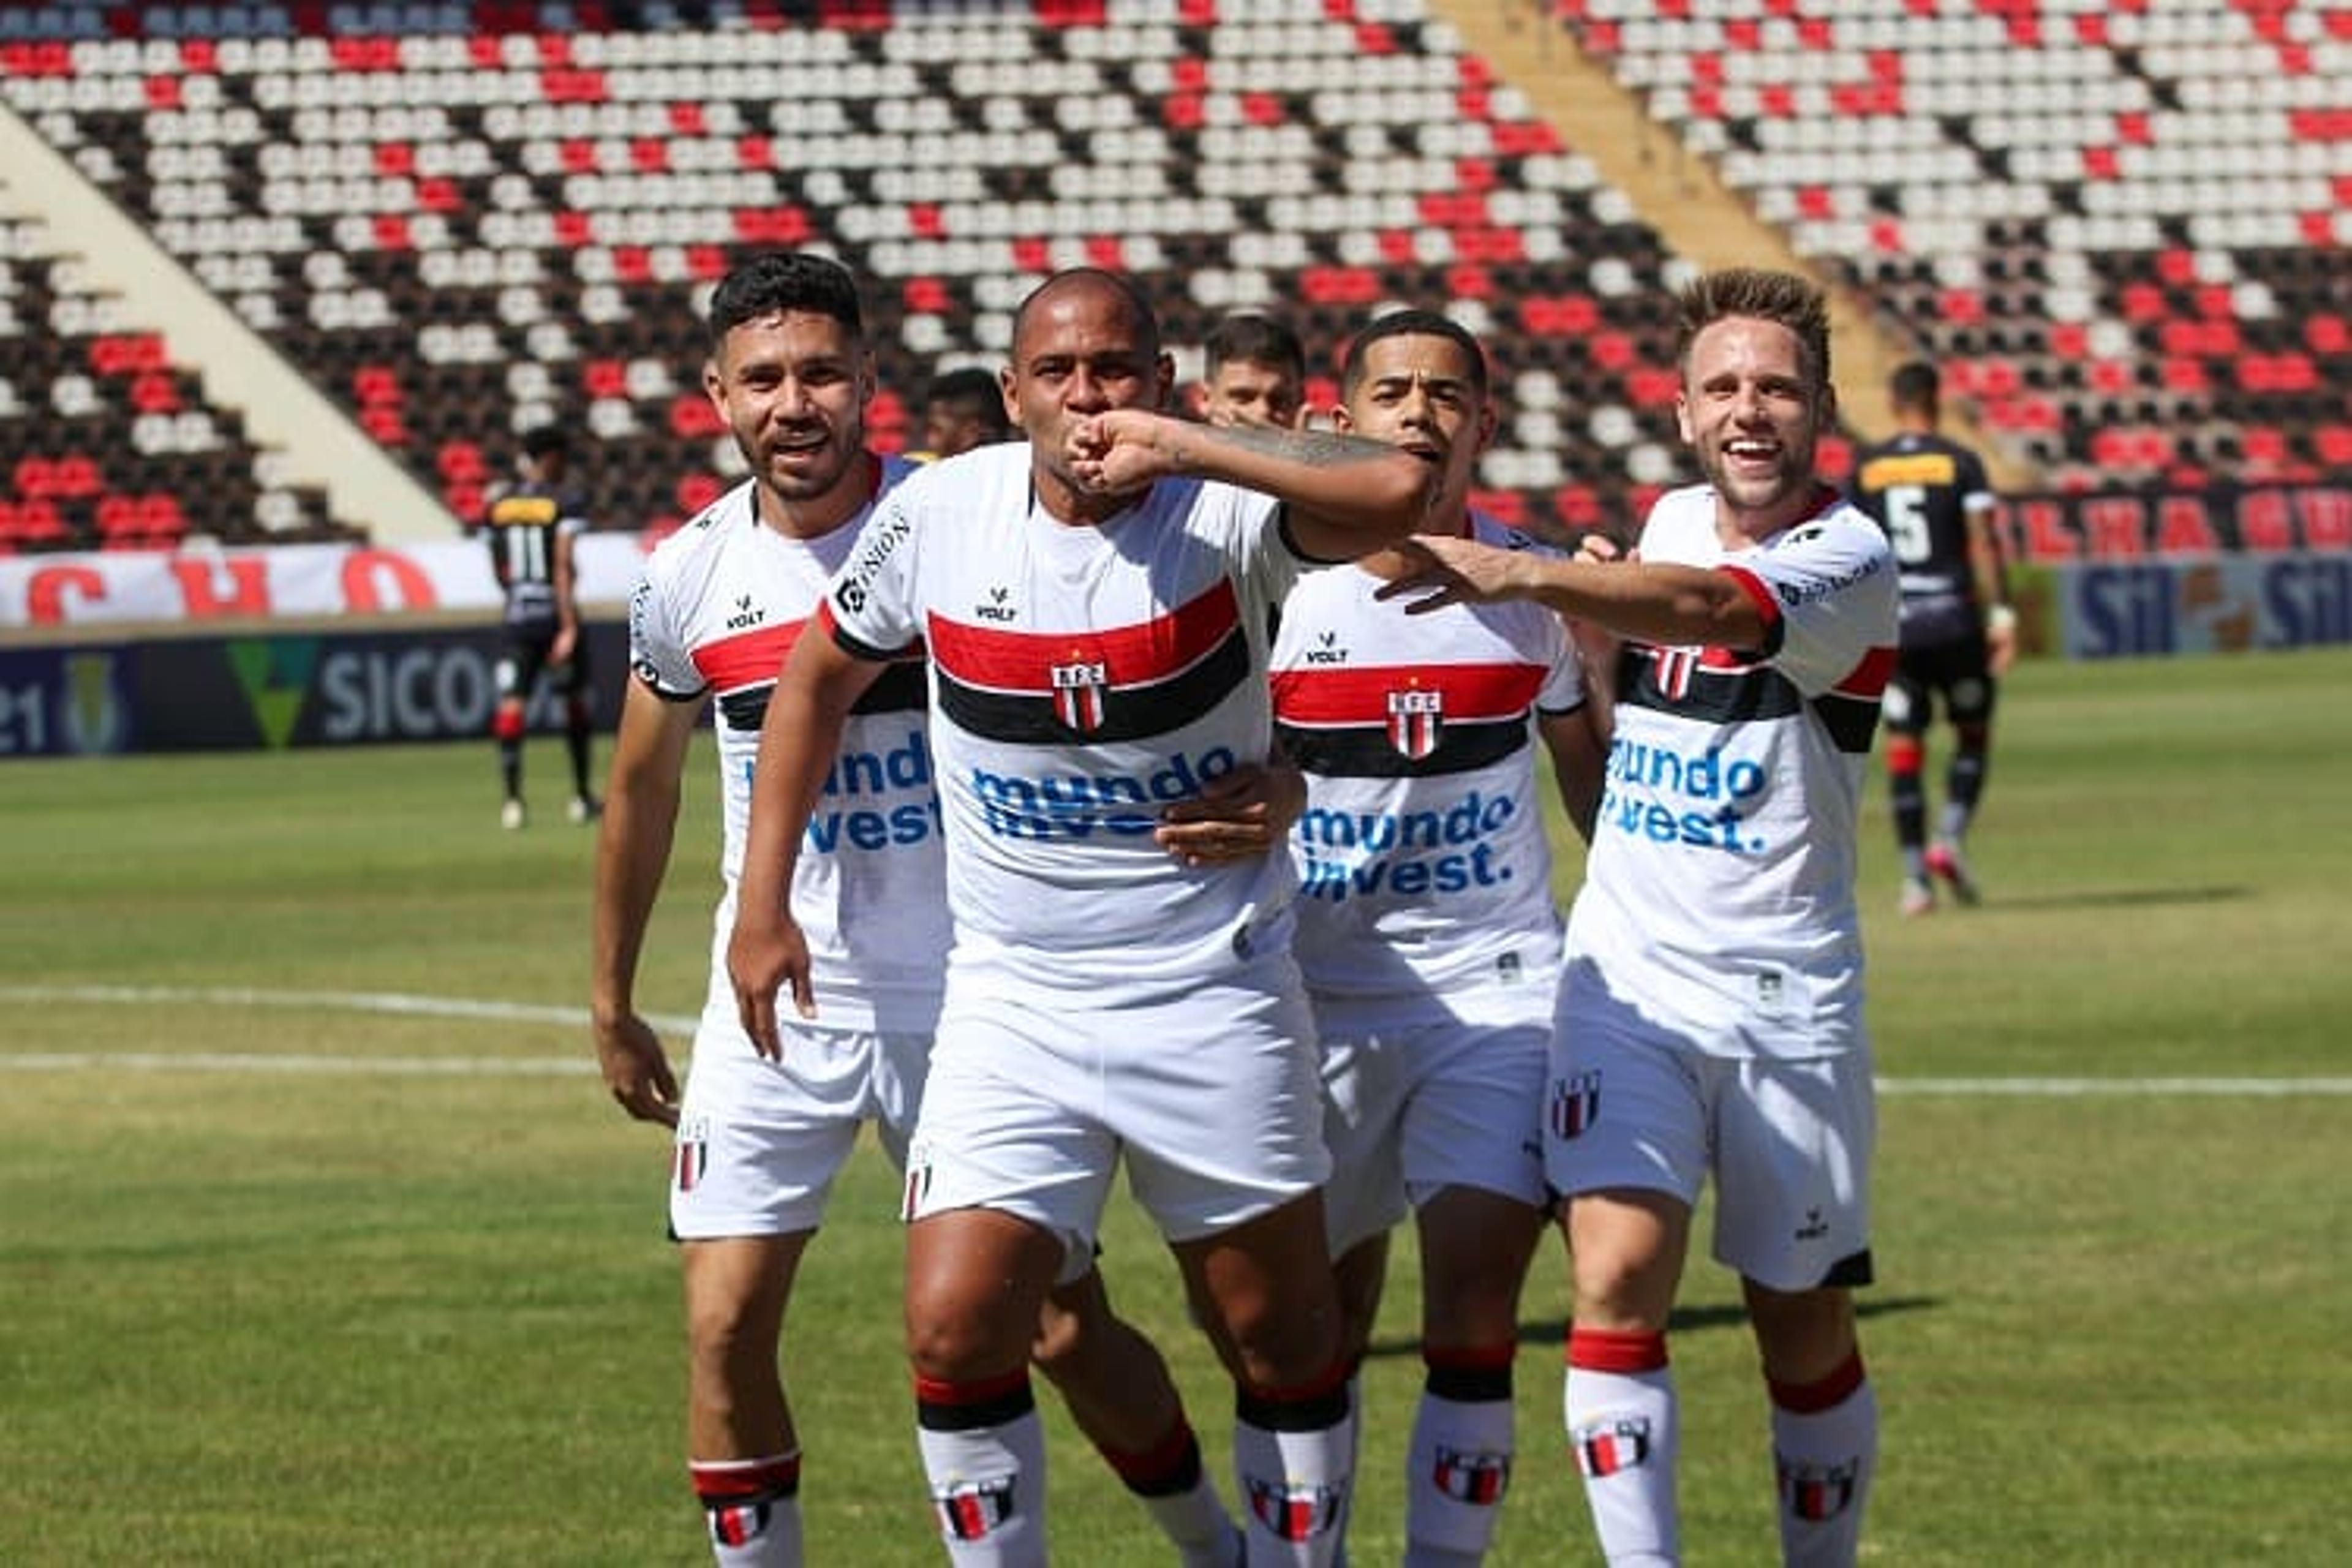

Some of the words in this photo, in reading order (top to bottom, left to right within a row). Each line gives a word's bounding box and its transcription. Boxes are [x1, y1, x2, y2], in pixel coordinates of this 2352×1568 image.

[508, 525, 546, 581] 11
[1885, 485, 1932, 564] 5
[726, 609, 766, 629] VOLT
[975, 605, 1017, 622] VOLT
[1306, 649, 1349, 663] VOLT
[322, 647, 595, 739] SICO
[973, 734, 1235, 812] mundo
[1300, 790, 1515, 851] mundo
